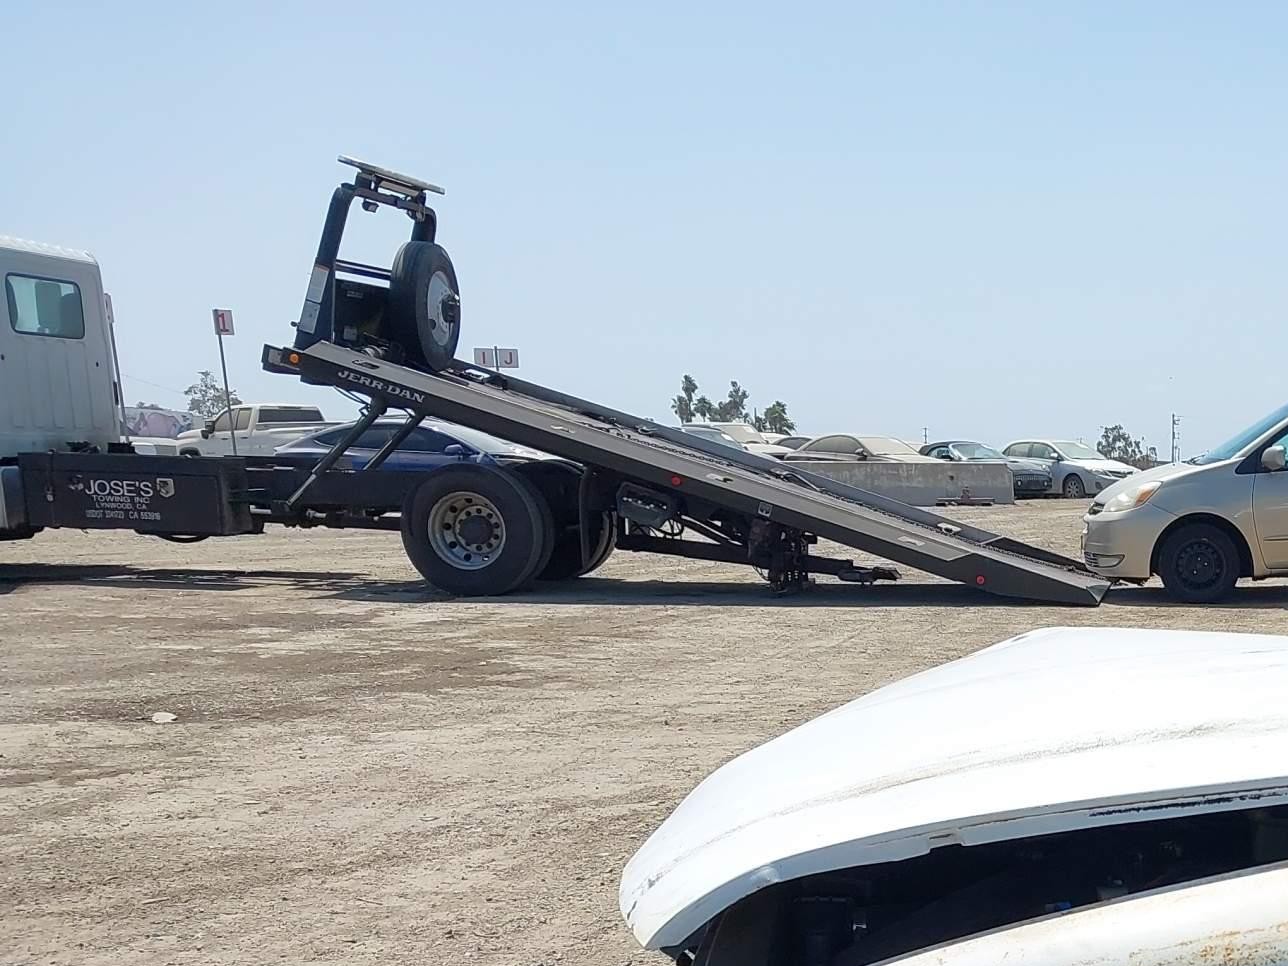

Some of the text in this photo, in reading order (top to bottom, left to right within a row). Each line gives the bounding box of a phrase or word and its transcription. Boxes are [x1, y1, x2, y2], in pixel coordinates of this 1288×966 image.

[217, 312, 230, 332] 1
[504, 351, 513, 365] J
[85, 479, 153, 497] JOSE'S
[91, 494, 150, 504] TOWING INC
[128, 511, 139, 519] CA
